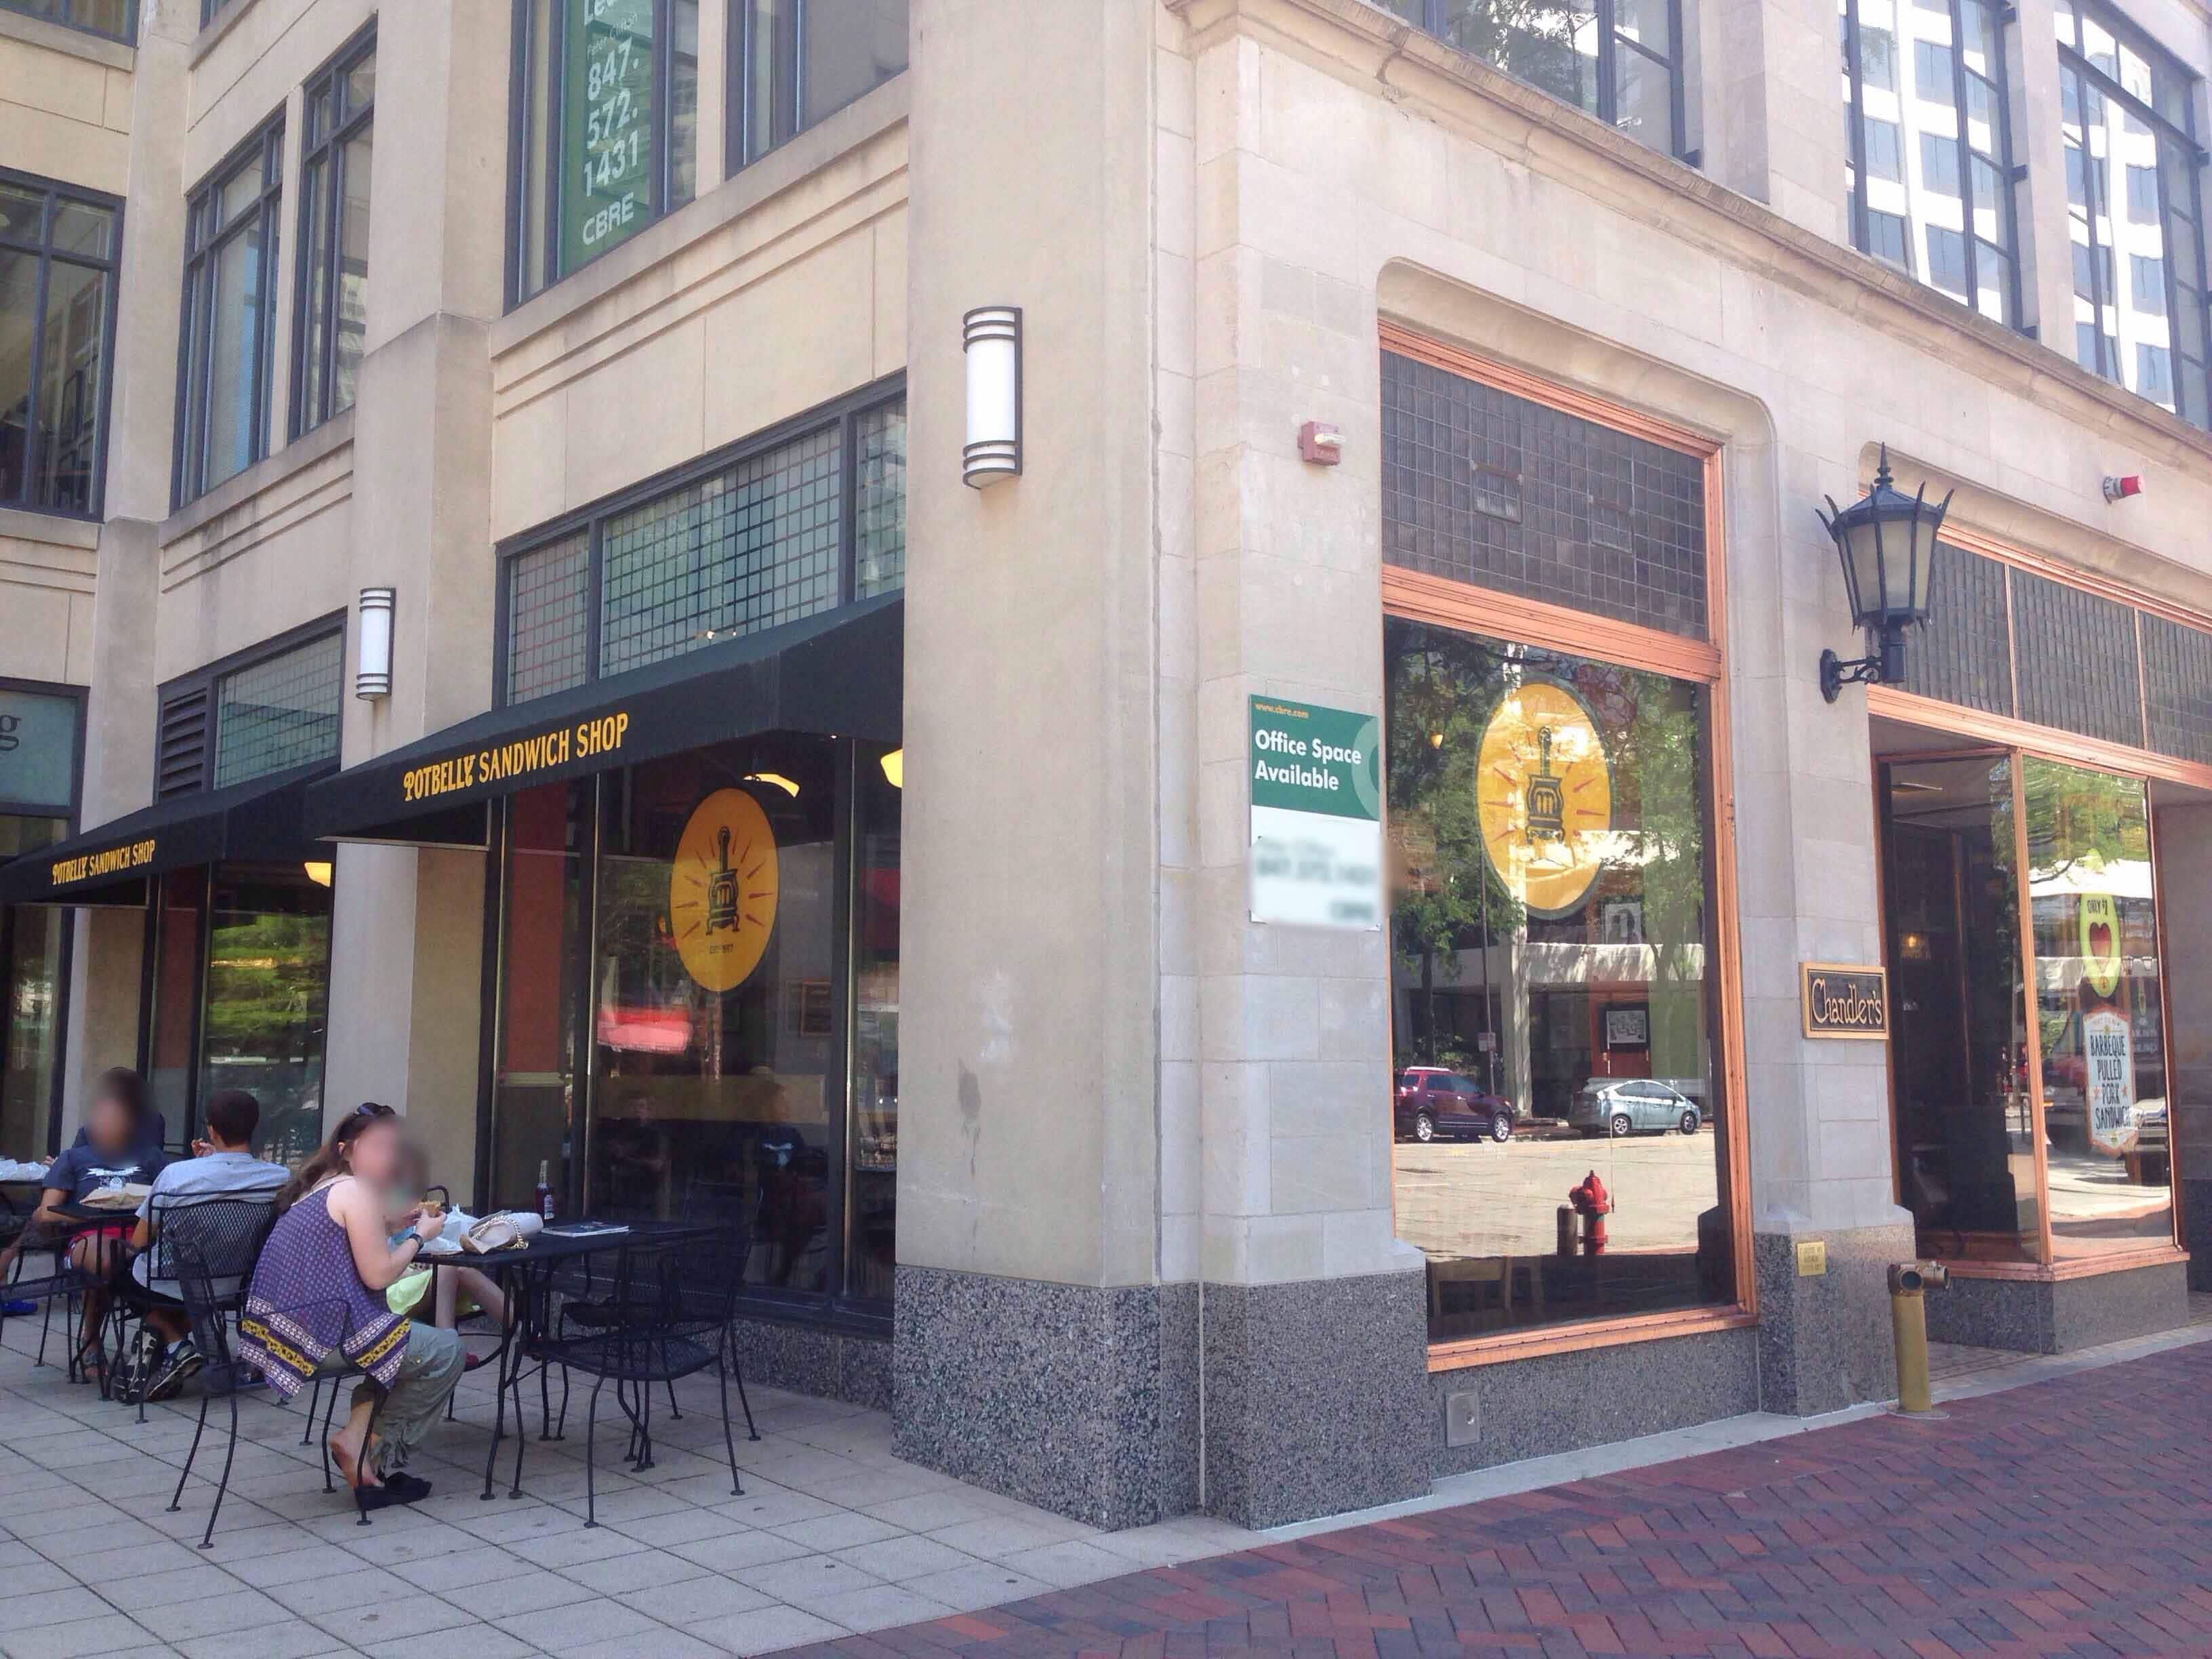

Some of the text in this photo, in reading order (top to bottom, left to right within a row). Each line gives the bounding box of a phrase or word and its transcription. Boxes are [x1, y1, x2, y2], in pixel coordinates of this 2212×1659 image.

[584, 0, 614, 26] Le
[588, 35, 639, 101] 847.
[587, 87, 638, 150] 572.
[584, 129, 638, 197] 1431
[583, 191, 634, 245] CBRE
[403, 713, 628, 802] POTBELLY SANDWICH SHOP
[1255, 729, 1361, 765] Office Space
[1254, 759, 1340, 791] Available
[52, 840, 156, 886] POTBELLY SANDWICH SHOP
[1811, 978, 1882, 1025] Chandler's
[2090, 1035, 2126, 1059] BARBEQUE
[2096, 1059, 2123, 1081] PULLED
[2102, 1084, 2120, 1105] PORK
